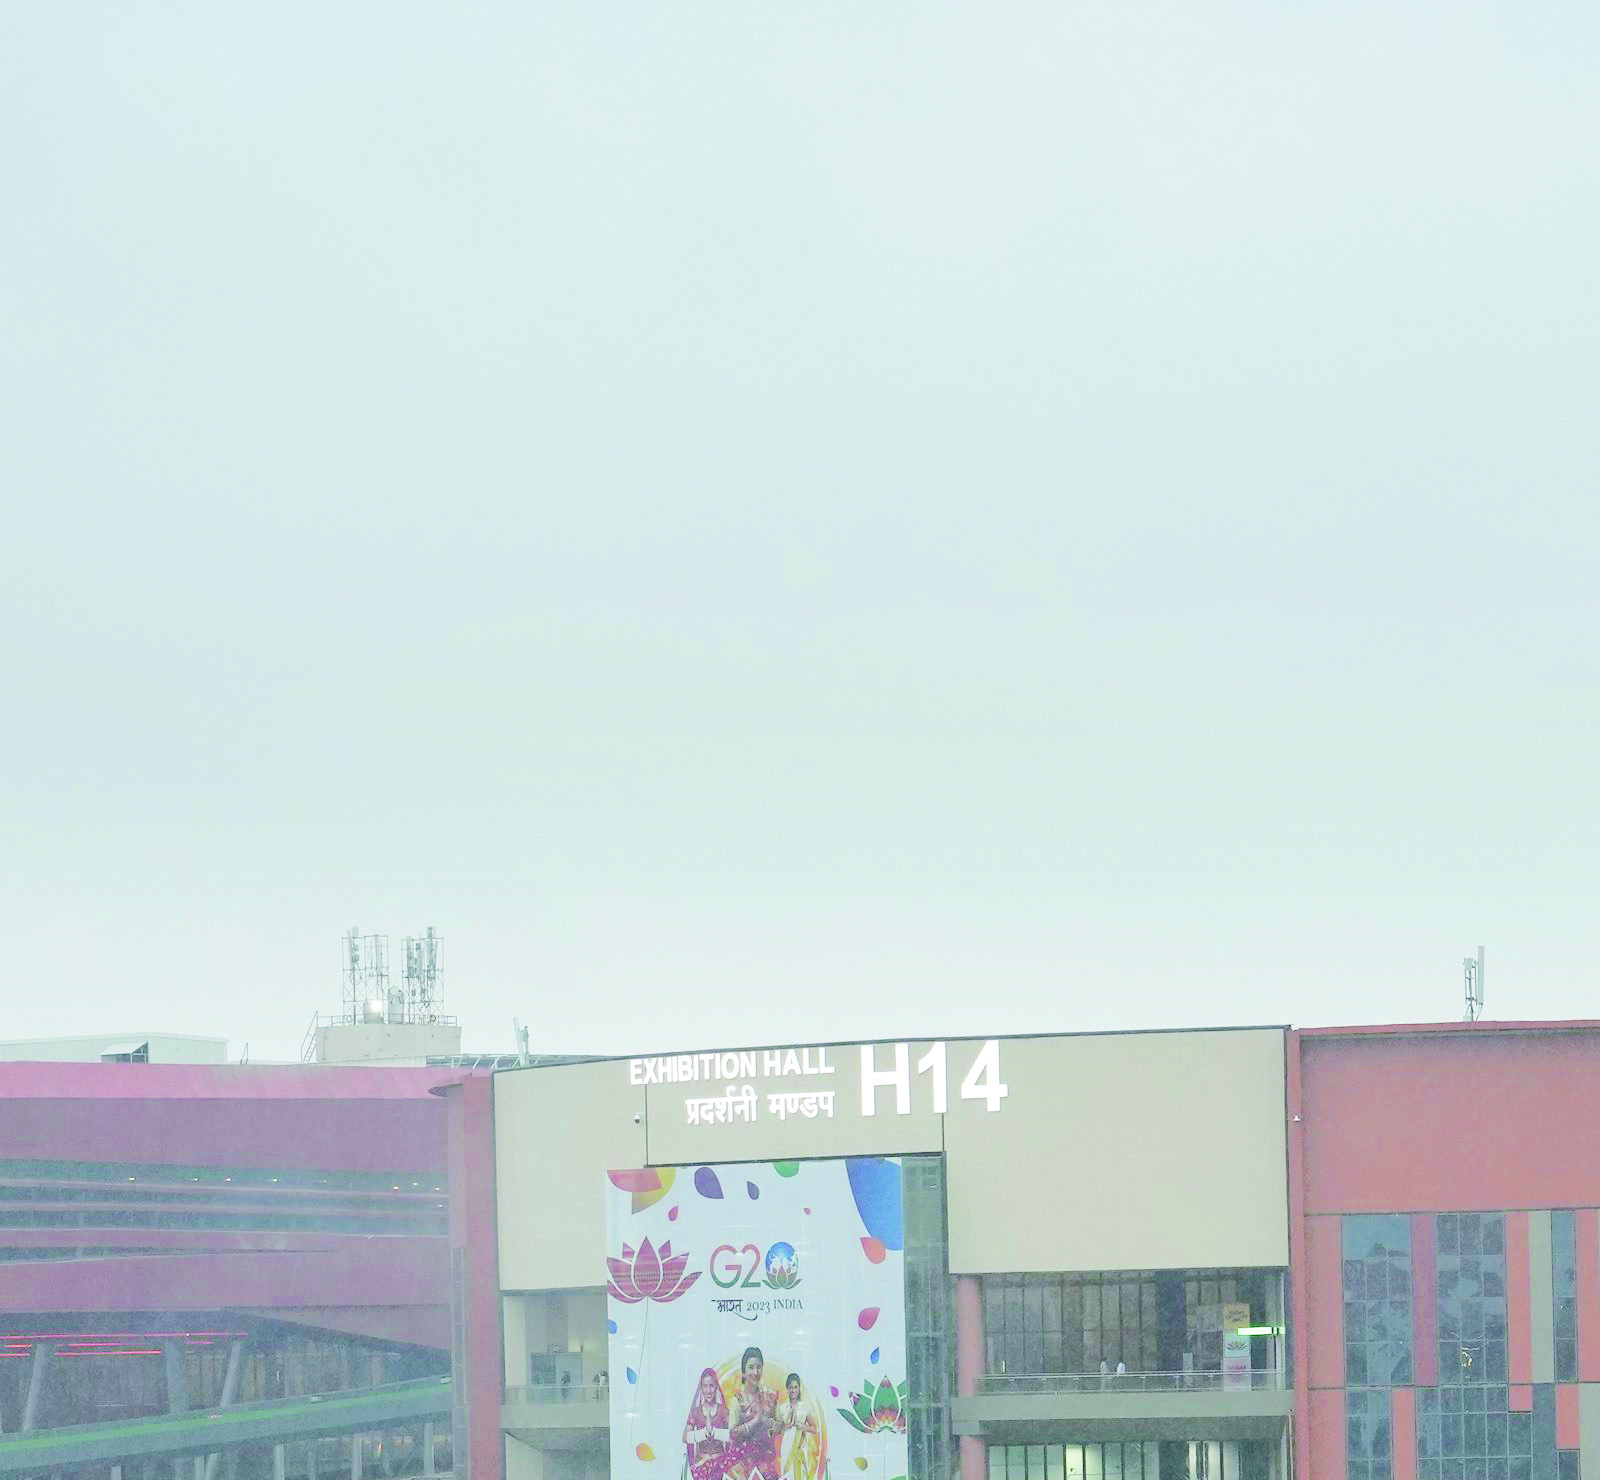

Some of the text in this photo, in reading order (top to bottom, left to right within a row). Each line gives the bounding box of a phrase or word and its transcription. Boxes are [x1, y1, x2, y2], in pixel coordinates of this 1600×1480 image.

[630, 1046, 836, 1085] EXHIBITION HALL
[860, 1040, 1009, 1117] H14
[685, 1085, 836, 1125] प्रदर्शनी मण्डप
[709, 1241, 803, 1290] G20
[746, 1299, 803, 1313] 2023 INDIA
